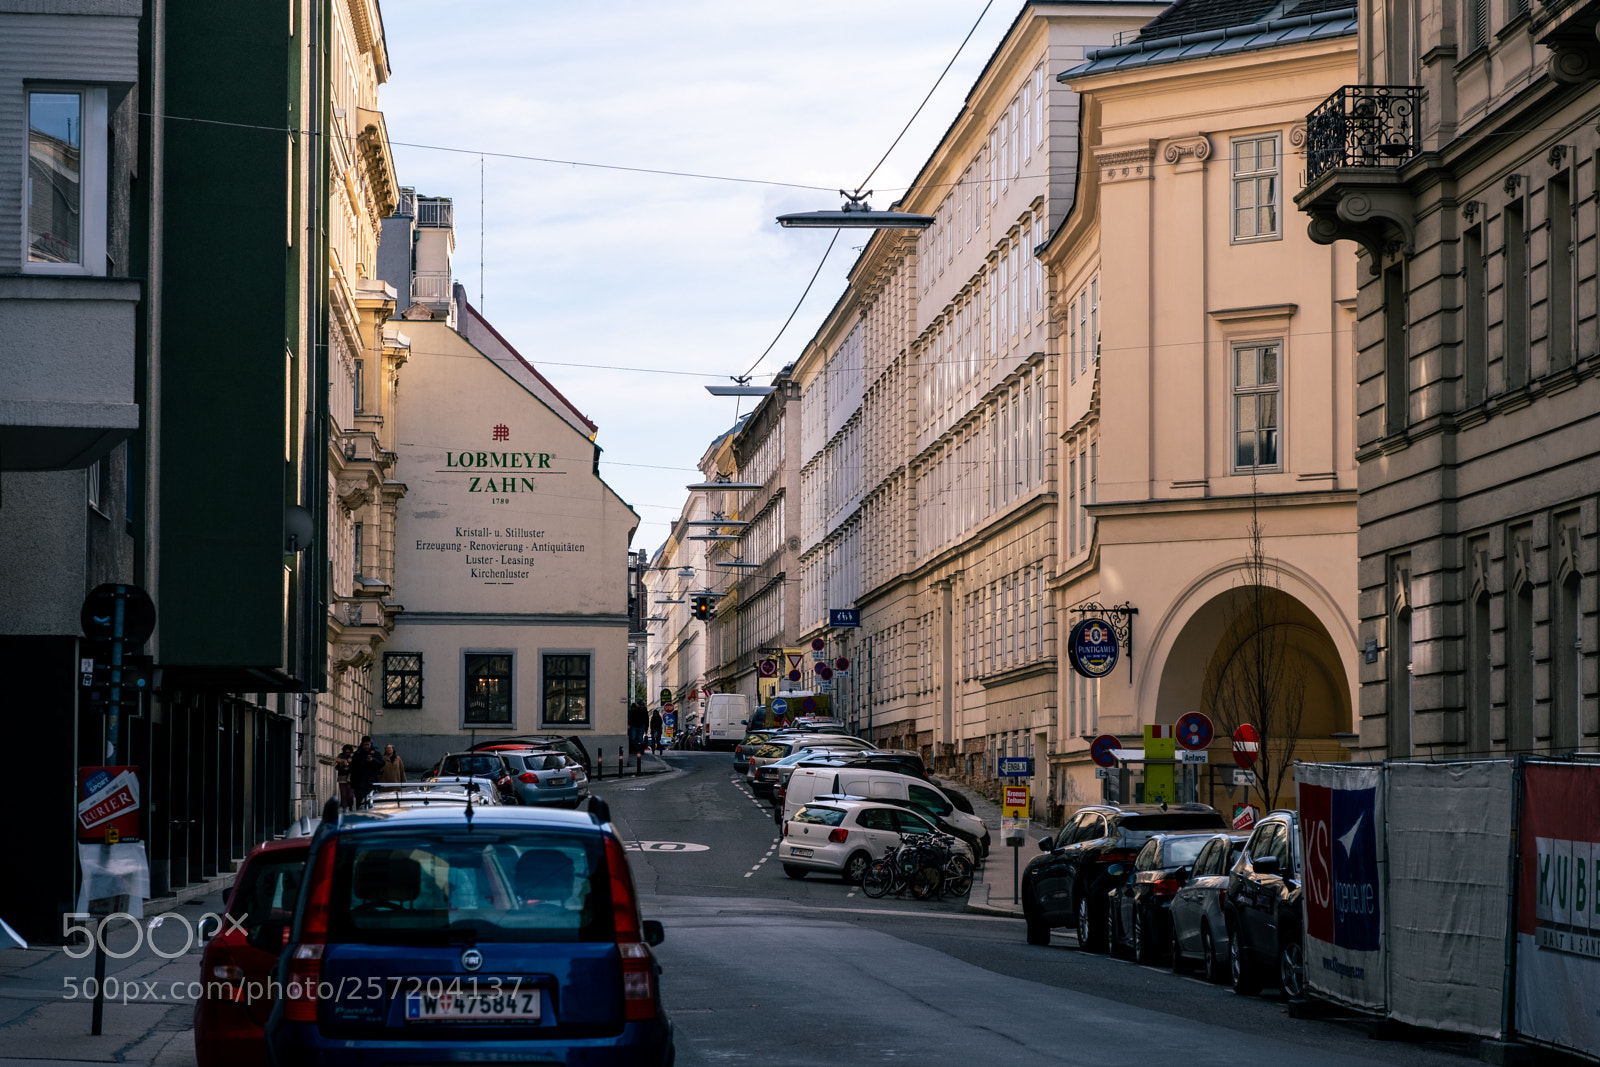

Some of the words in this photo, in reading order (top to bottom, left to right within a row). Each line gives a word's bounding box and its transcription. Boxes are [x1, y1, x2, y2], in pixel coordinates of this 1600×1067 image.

[468, 477, 535, 493] ZAHN
[491, 497, 510, 505] 1780
[455, 526, 492, 538] Kristall-
[494, 529, 503, 538] u.
[505, 527, 545, 539] Stilluster
[416, 540, 462, 553] Erzeugung
[469, 540, 524, 553] Renovierung
[530, 541, 585, 553] Antiquitäten
[465, 554, 493, 565] Luster
[500, 555, 535, 567] Leasing
[470, 568, 530, 579] Kirchenluster
[1078, 645, 1116, 654] PUNTIGAMER
[1184, 754, 1206, 763] Anfang
[1006, 789, 1026, 798] Kronen
[83, 791, 133, 824] KURIER
[1006, 797, 1026, 805] Zeitung
[1304, 817, 1331, 909] KS
[423, 994, 437, 1014] W
[453, 994, 518, 1014] 47584
[522, 994, 534, 1014] Z
